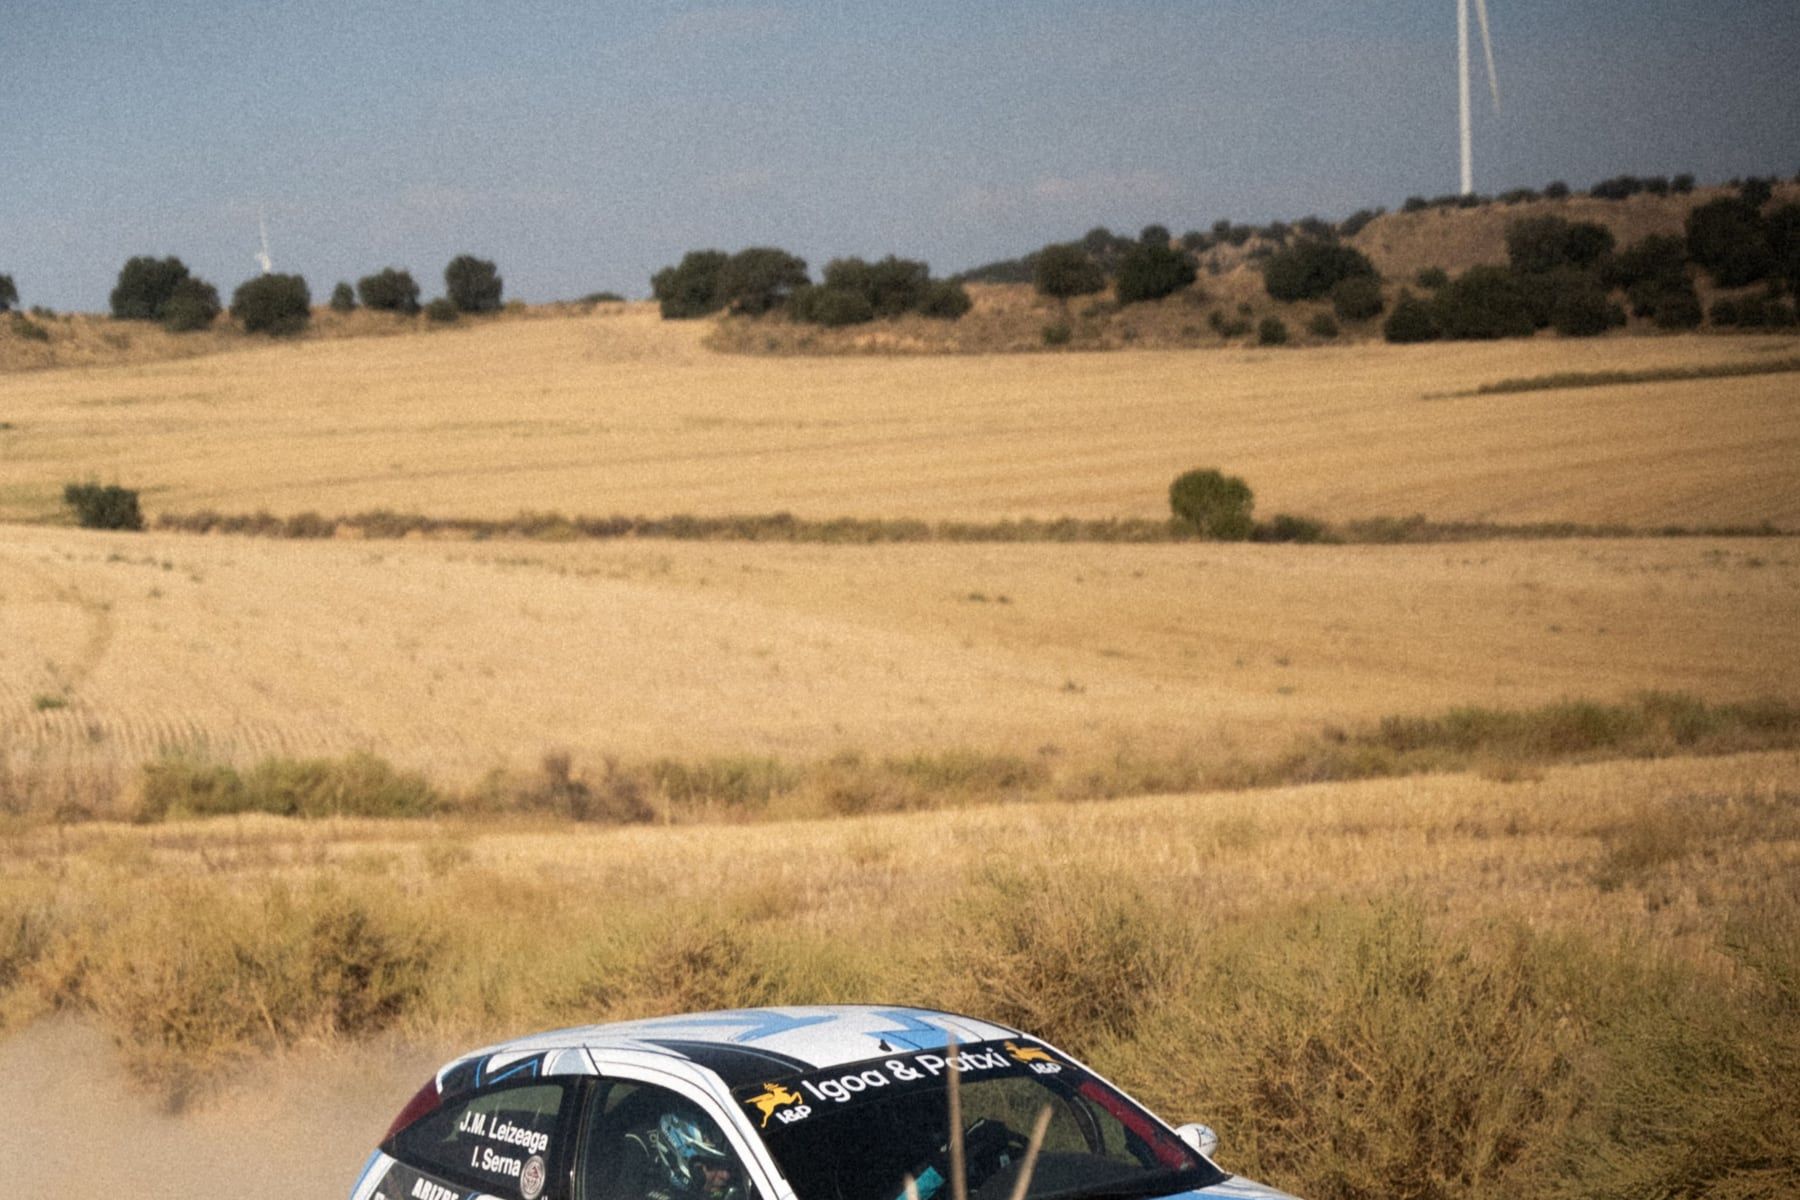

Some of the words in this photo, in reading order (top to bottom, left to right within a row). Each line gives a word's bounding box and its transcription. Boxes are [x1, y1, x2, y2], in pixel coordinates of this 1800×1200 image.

[801, 1069, 890, 1102] Igoa
[885, 1059, 925, 1081] &
[915, 1047, 1012, 1076] Patxi
[459, 1111, 486, 1137] J.M.
[488, 1116, 549, 1154] Leizeaga
[776, 1104, 812, 1124] I&P
[471, 1145, 479, 1168] I.
[481, 1147, 522, 1177] Serna
